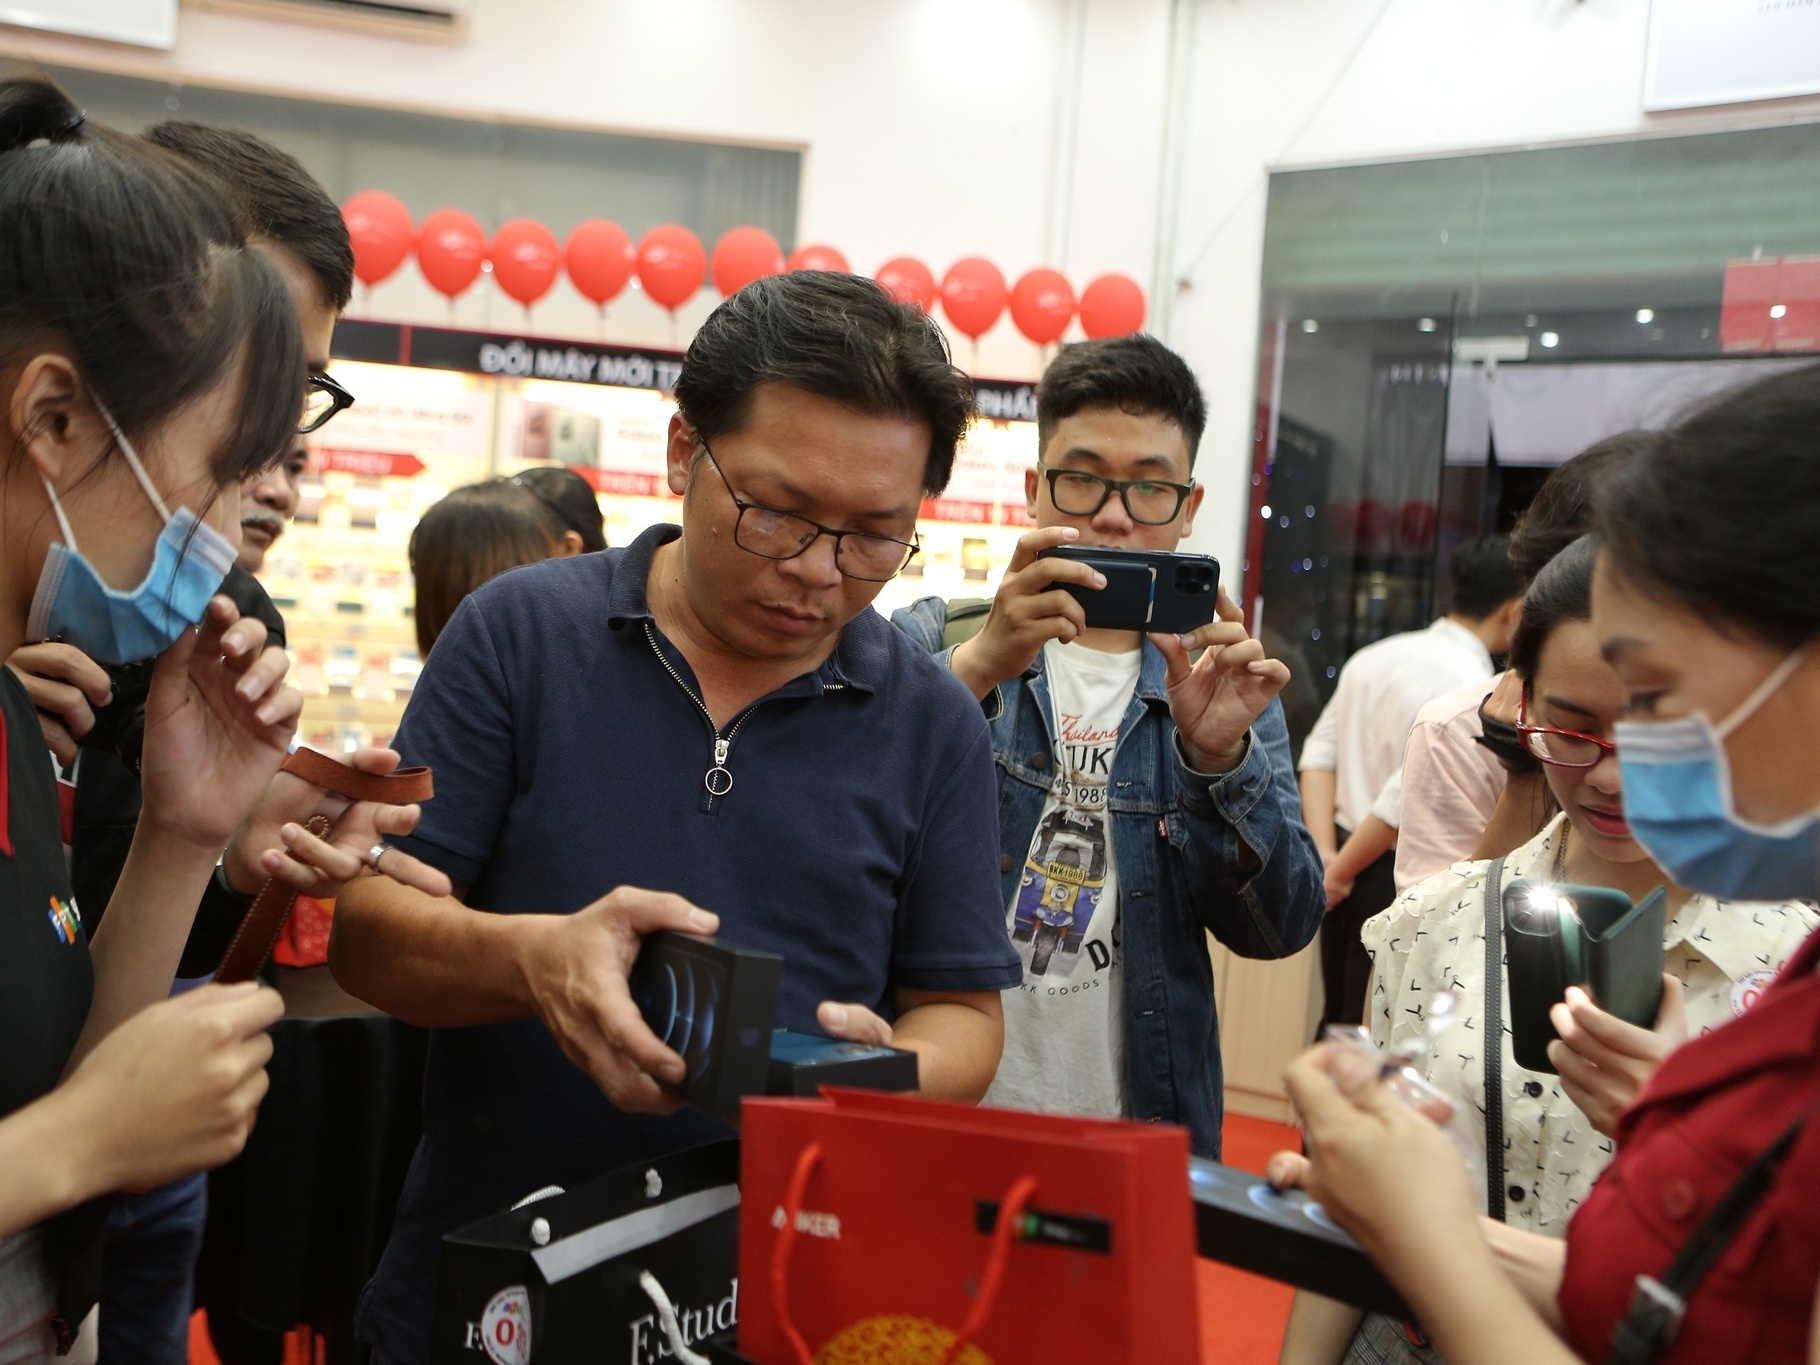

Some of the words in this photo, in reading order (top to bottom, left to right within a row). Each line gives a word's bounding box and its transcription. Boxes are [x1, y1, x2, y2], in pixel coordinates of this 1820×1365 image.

[535, 347, 597, 382] MÁY
[598, 353, 654, 387] MỚI
[1048, 979, 1100, 995] GOODS
[771, 1205, 841, 1240] AKER
